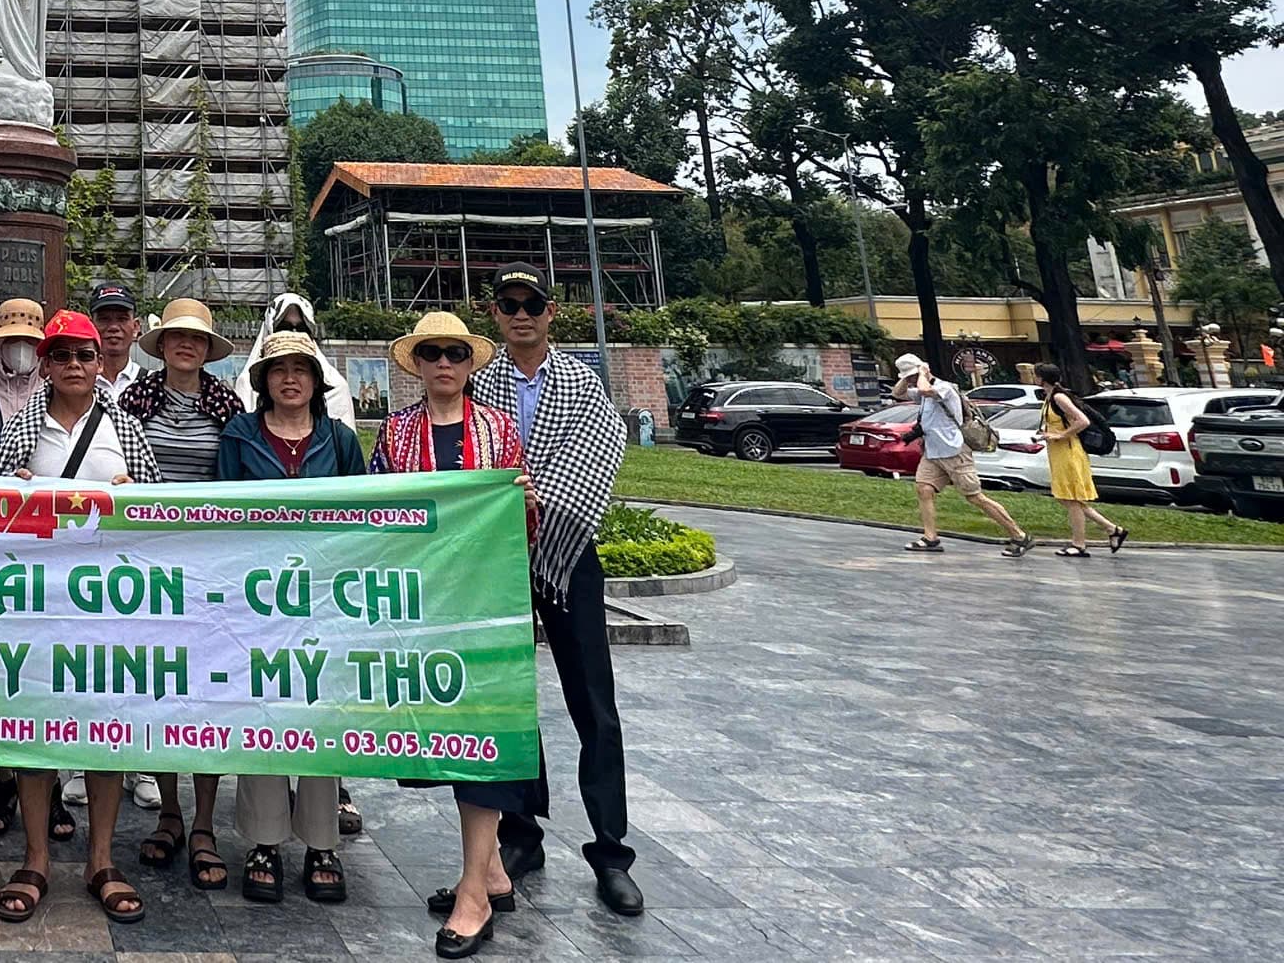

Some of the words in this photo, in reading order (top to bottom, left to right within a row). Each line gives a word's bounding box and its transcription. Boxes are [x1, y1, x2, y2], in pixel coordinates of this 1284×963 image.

[126, 504, 179, 520] CHÀO
[186, 505, 242, 521] MỪNG
[248, 507, 304, 522] ĐOÀN
[310, 510, 364, 522] THAM
[369, 509, 426, 525] QUAN
[67, 553, 185, 615] GÒN
[244, 556, 311, 617] CỦ
[332, 569, 421, 626] CHI
[52, 643, 188, 701] NINH
[250, 637, 329, 706] MỸ
[347, 650, 465, 709] THO
[45, 717, 78, 743] HÀ
[89, 719, 132, 750] NỘI
[164, 721, 231, 750] NGÀY
[242, 728, 315, 751] 30.04
[343, 731, 498, 760] 03.05.2026
